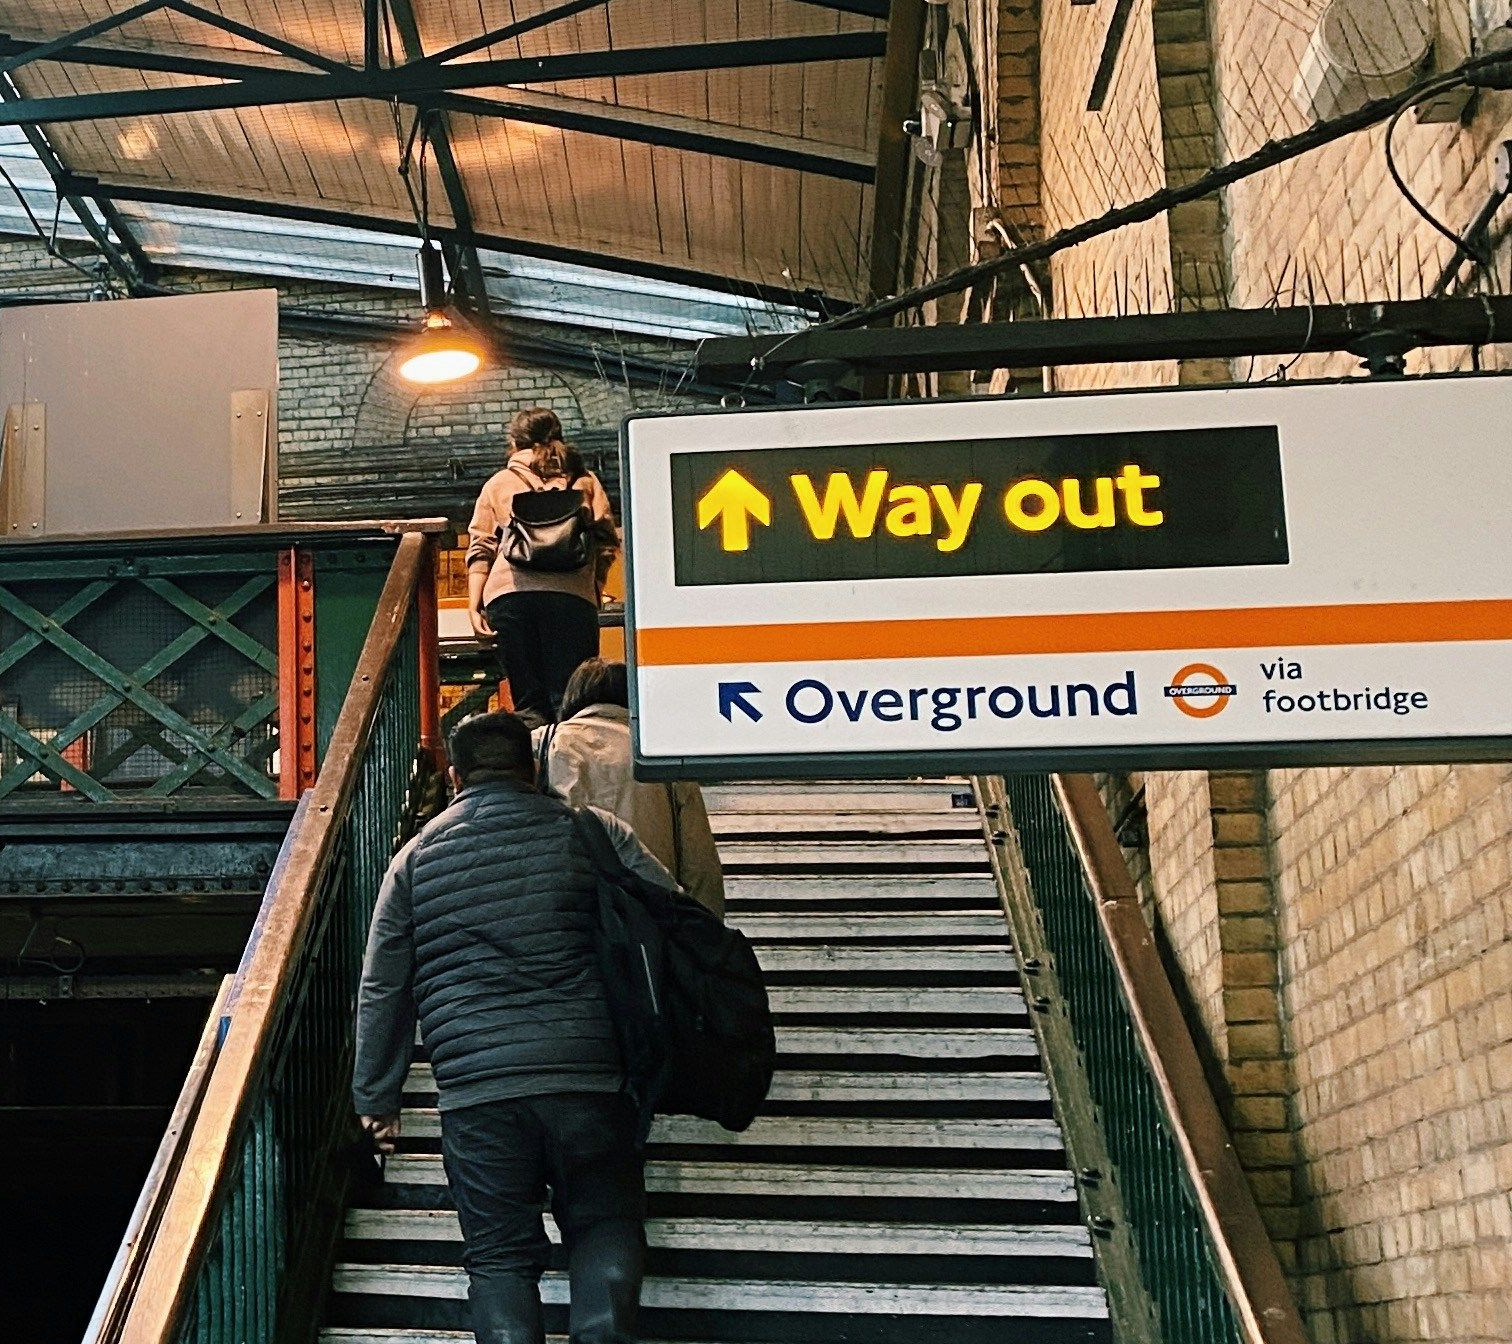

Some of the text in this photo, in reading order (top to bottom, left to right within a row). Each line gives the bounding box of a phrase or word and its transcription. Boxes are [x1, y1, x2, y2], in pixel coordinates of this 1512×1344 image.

[790, 464, 1164, 552] Way out
[1259, 656, 1303, 680] via
[785, 670, 1139, 733] Overground
[1168, 685, 1233, 696] OVERGROUND
[1262, 686, 1429, 715] footbridge
